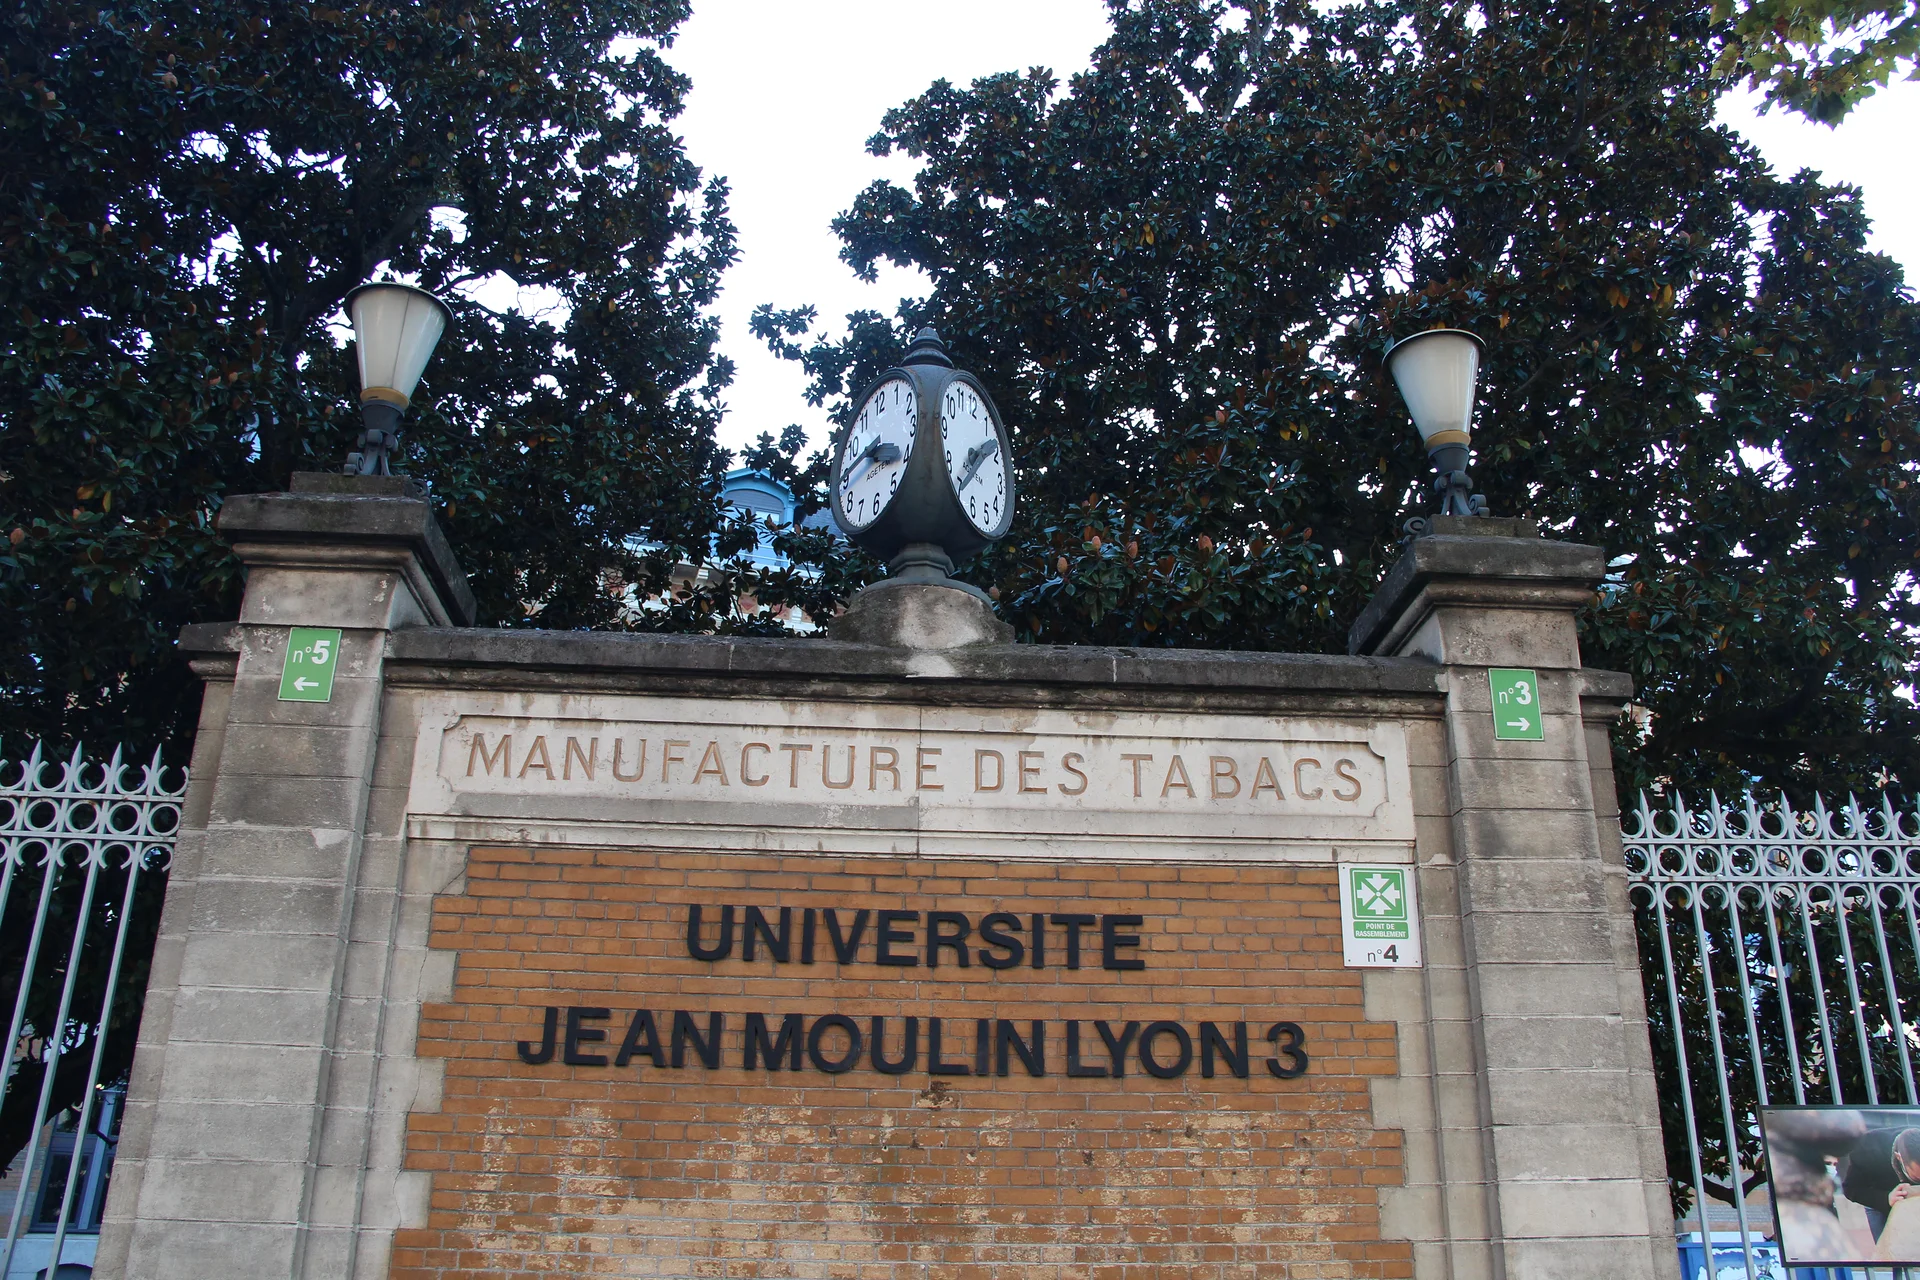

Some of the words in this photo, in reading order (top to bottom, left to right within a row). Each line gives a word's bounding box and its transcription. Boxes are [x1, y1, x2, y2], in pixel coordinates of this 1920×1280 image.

[875, 391, 885, 416] 12
[894, 384, 899, 405] 1
[906, 392, 912, 416] 2
[946, 393, 956, 419] 10
[957, 387, 964, 412] 11
[968, 393, 977, 420] 12
[860, 410, 868, 433] 11
[910, 414, 916, 437] 3
[941, 416, 948, 440] 9
[984, 416, 988, 436] 1
[849, 436, 859, 460] 10
[903, 444, 910, 464] 4
[946, 450, 953, 474] 8
[890, 472, 897, 496] 5
[997, 472, 1003, 495] 3
[847, 491, 853, 513] 8
[858, 498, 865, 522] 7
[873, 492, 880, 516] 6
[970, 496, 976, 519] 6
[984, 502, 990, 525] 5
[993, 495, 999, 517] 4
[465, 733, 944, 792] MANUFACTURE
[974, 748, 1088, 796] DES
[1120, 753, 1362, 801] TABACS
[687, 903, 1146, 971] UNIVERSITE
[1355, 930, 1406, 938] RASSEMBLEMENT
[517, 1006, 723, 1070] JEAN
[743, 1013, 1045, 1077] MOULIN
[1067, 1019, 1249, 1080] LYON
[1266, 1021, 1310, 1079] 3
